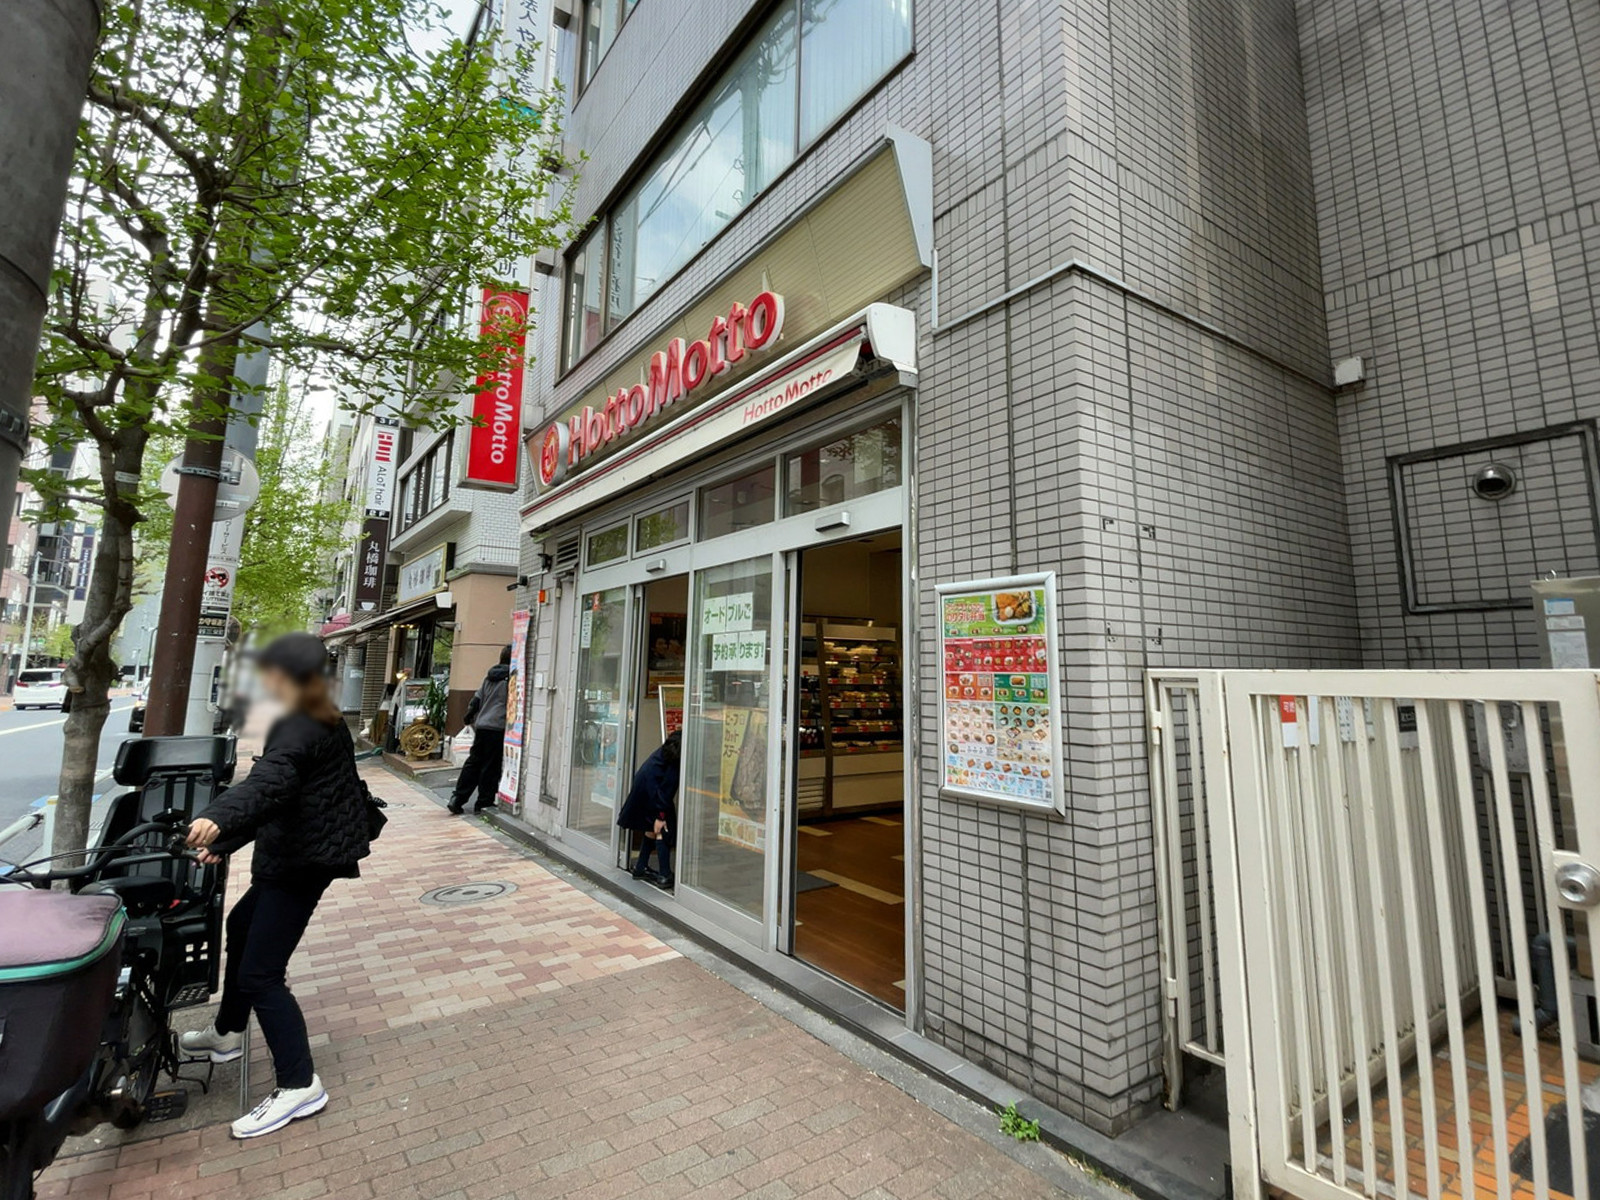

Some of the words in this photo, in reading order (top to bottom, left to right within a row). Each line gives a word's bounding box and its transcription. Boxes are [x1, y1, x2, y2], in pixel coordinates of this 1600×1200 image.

[567, 291, 784, 468] HottoMotto
[743, 369, 832, 424] HottoMotto
[704, 603, 752, 624] オードブルご
